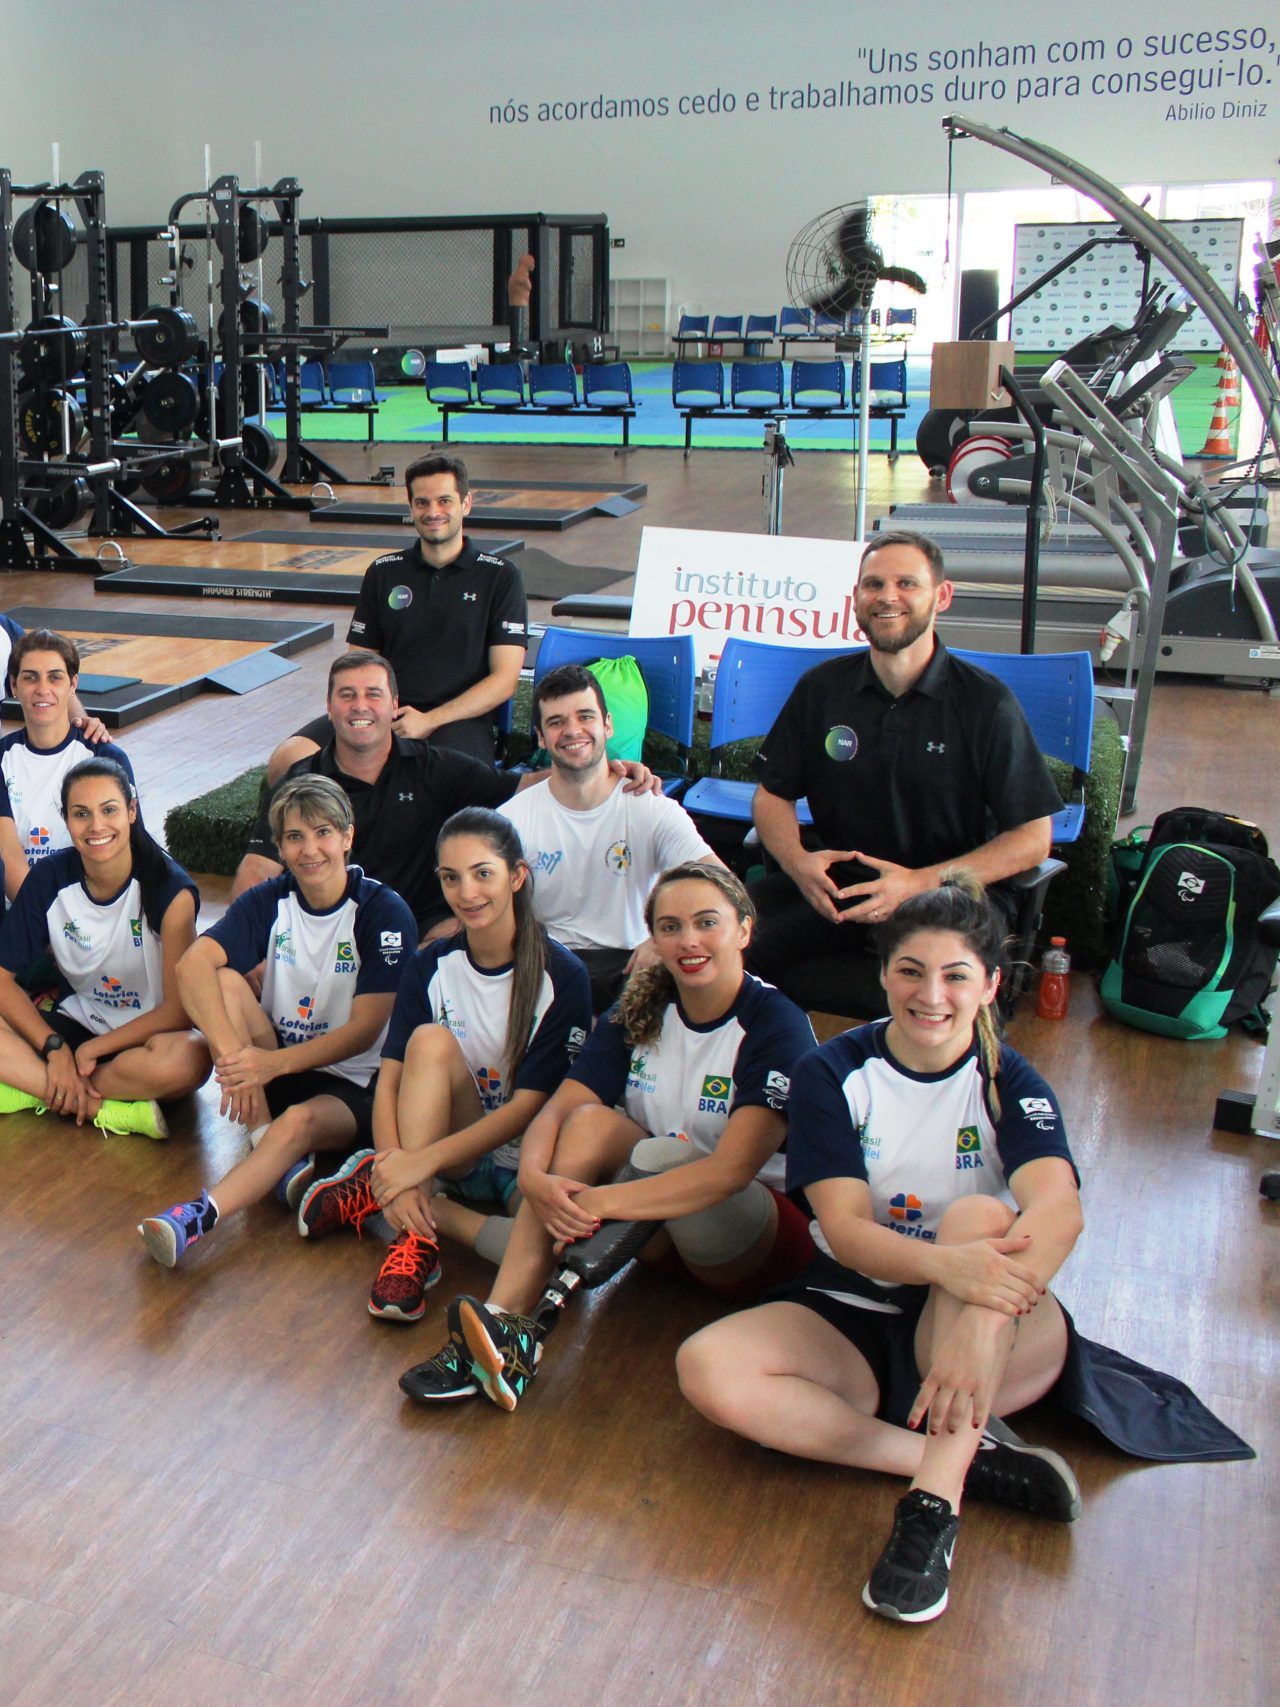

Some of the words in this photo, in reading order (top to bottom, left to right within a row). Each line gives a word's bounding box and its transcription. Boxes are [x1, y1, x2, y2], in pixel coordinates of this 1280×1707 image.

[857, 46, 918, 74] "Uns
[927, 41, 1036, 71] sonham
[1047, 37, 1106, 64] com
[1116, 36, 1133, 58] o
[1144, 27, 1277, 58] sucesso,
[489, 98, 529, 124] nós
[537, 94, 670, 122] acordamos
[678, 88, 737, 115] cedo
[745, 91, 760, 112] e
[769, 80, 935, 110] trabalhamos
[944, 75, 1007, 102] duro
[1016, 76, 1081, 104] para
[1165, 101, 1216, 122] Abilio
[1222, 98, 1268, 119] Diniz
[202, 586, 235, 597] HAMMER
[236, 588, 273, 599] STRENGTH
[673, 566, 818, 603] instituto
[838, 737, 853, 748] NAR
[334, 962, 357, 973] BRA
[93, 987, 139, 999] Loterias
[279, 1016, 329, 1032] Loterias
[698, 1098, 728, 1115] BRA
[955, 1153, 984, 1170] BRA
